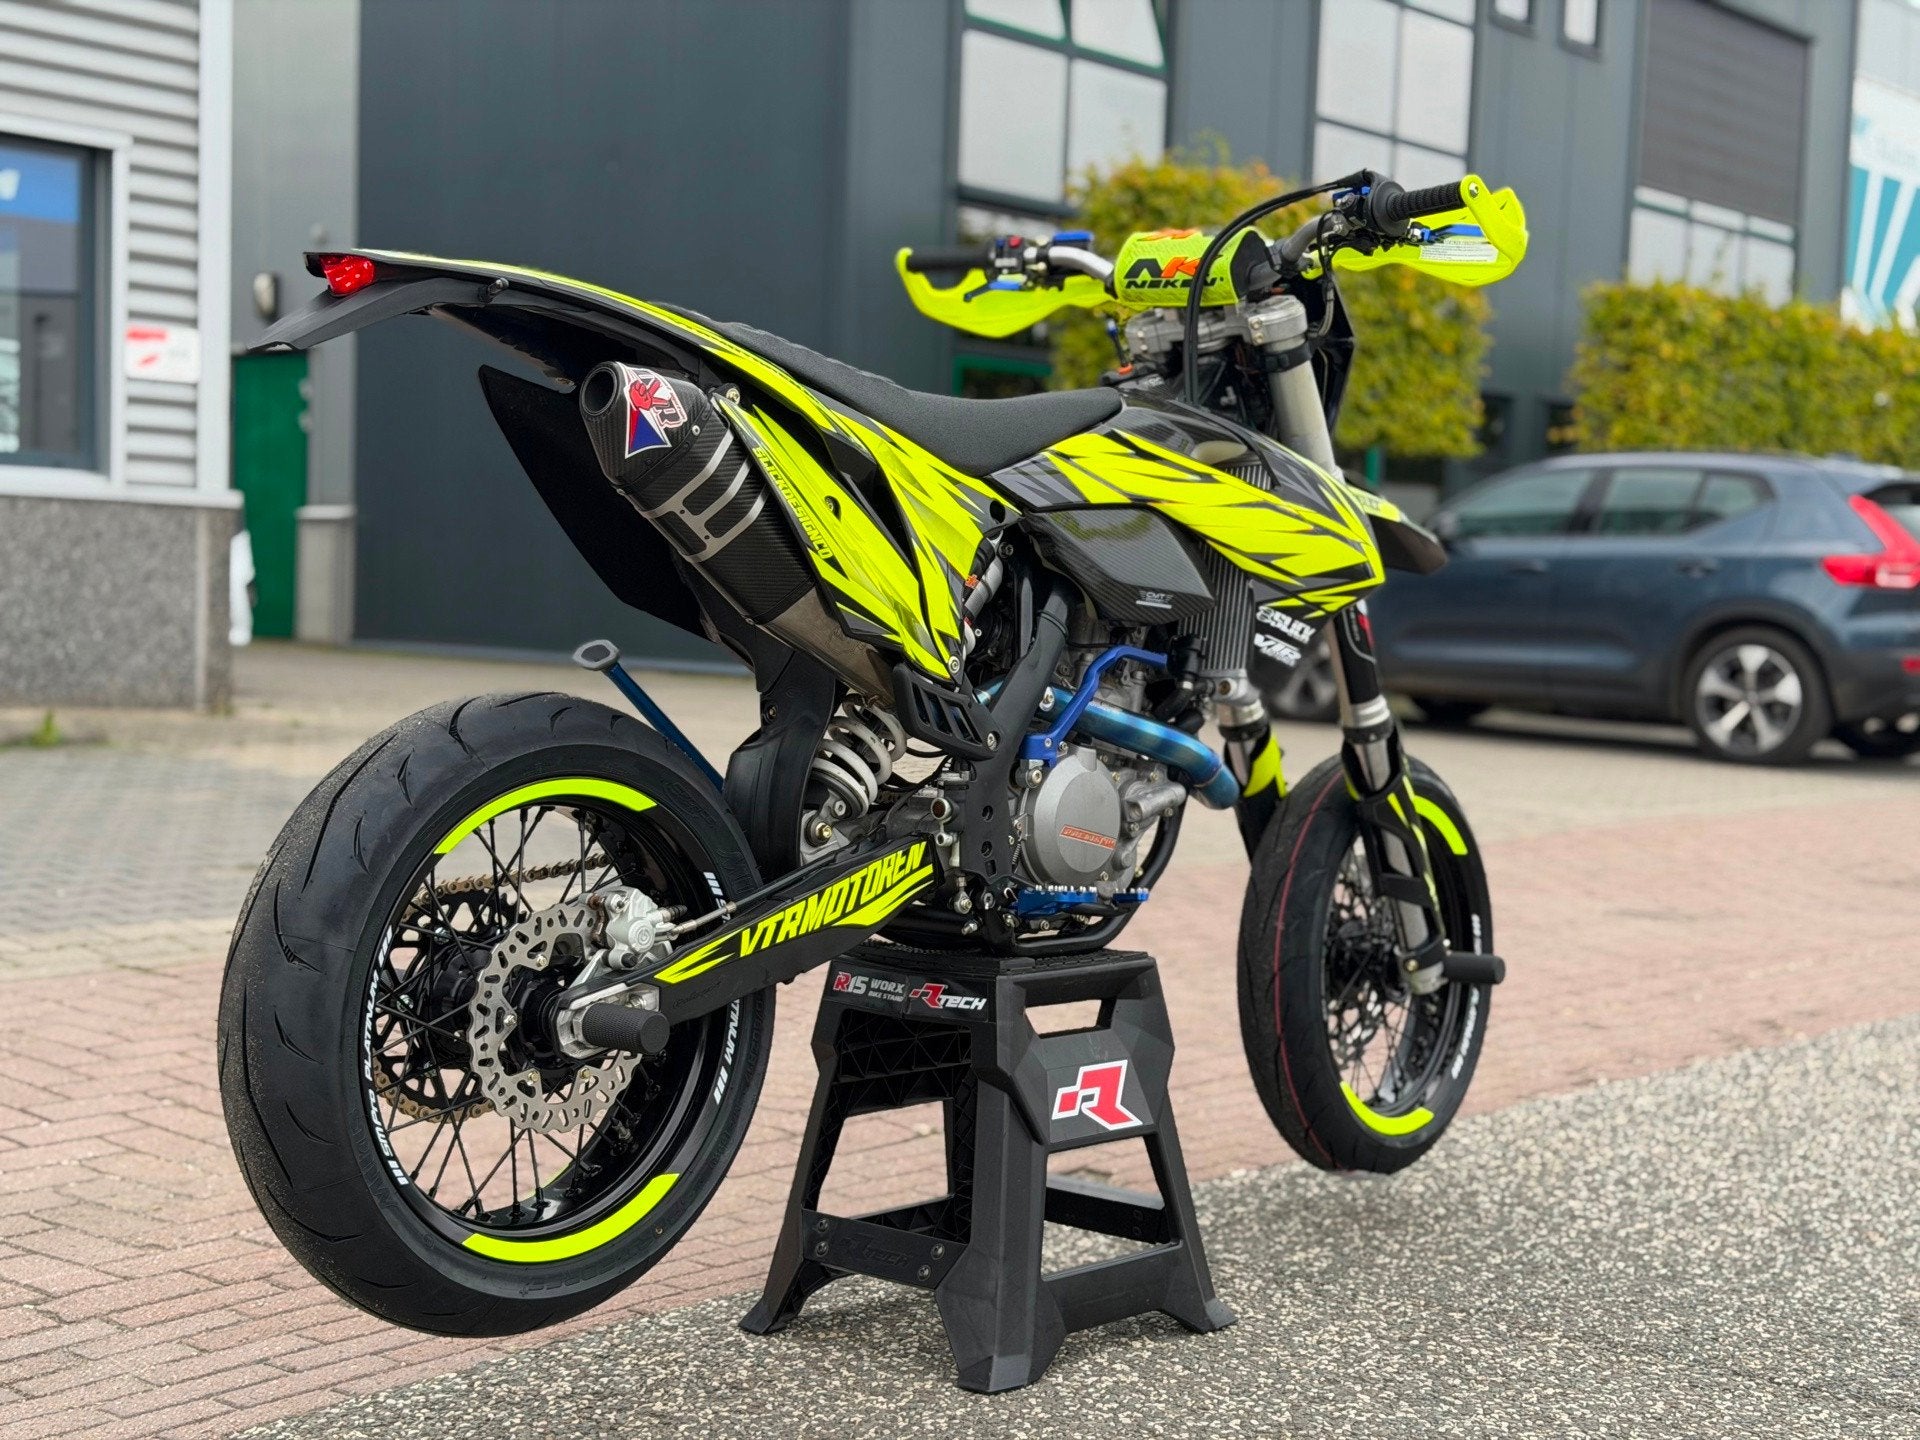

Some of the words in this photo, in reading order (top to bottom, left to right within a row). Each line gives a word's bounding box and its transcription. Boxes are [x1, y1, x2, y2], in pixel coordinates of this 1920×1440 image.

[740, 841, 927, 958] VTRMOTOREN
[364, 969, 379, 1081] PLATINUM
[870, 979, 905, 994] WORX
